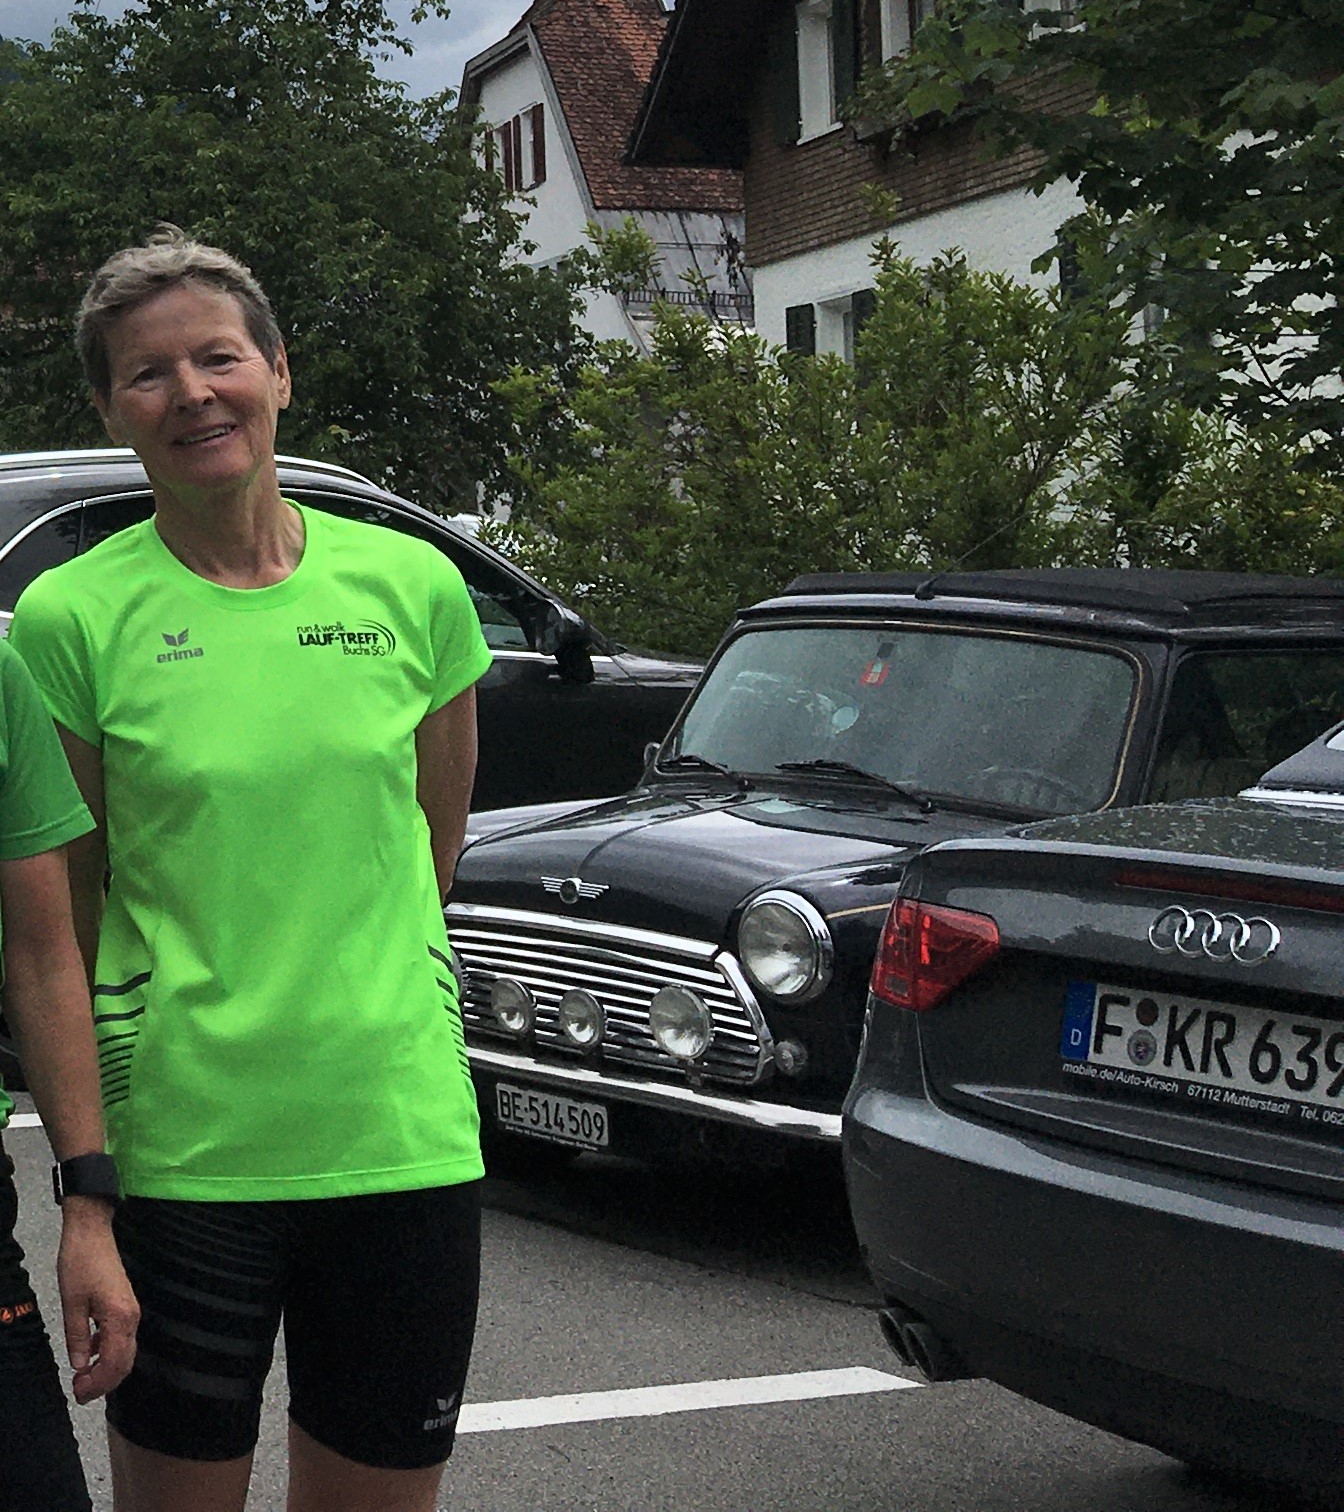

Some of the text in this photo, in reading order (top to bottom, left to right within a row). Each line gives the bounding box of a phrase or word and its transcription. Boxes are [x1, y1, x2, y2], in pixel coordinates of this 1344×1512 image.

[298, 633, 379, 646] LAUF-TREFF
[156, 647, 205, 664] erima
[342, 643, 386, 657] Buchs SG
[1070, 1028, 1082, 1046] D
[1092, 994, 1131, 1055] F
[1163, 1005, 1237, 1078] KR
[1062, 1062, 1179, 1093] mobile.de/Auto-Kirsch
[1187, 1085, 1220, 1102] 67112
[1223, 1090, 1291, 1115] Mutterstadt
[1300, 1105, 1319, 1121] Tel.
